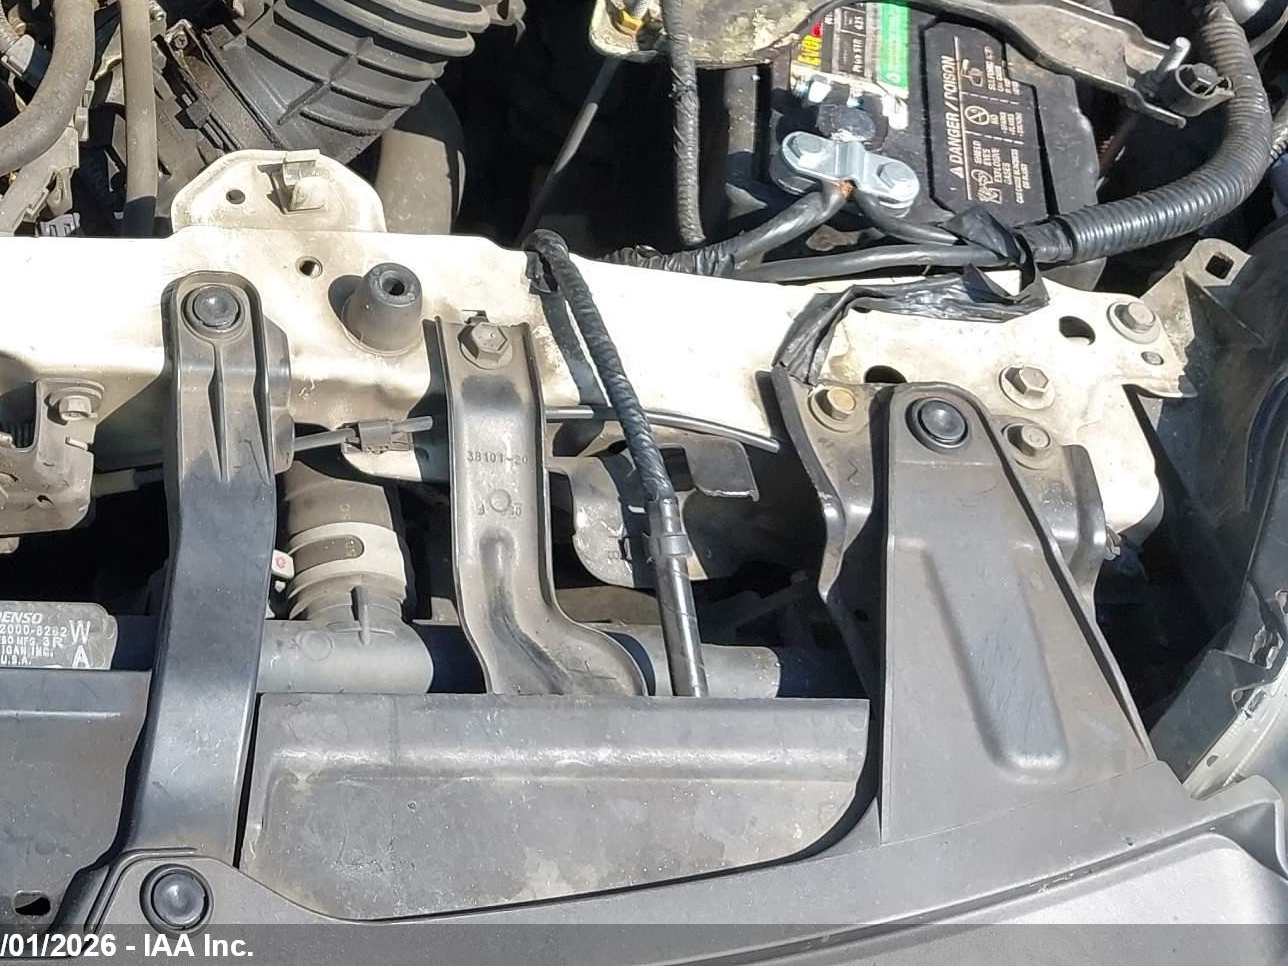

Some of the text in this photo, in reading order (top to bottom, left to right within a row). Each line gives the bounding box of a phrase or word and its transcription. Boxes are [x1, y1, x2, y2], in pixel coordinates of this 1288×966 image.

[941, 55, 958, 101] POISON
[945, 112, 964, 164] DANGER
[972, 140, 982, 164] SHIELD
[983, 148, 992, 166] EYES
[992, 148, 1003, 183] EXPLOSIVE
[1002, 162, 1012, 185] GASES
[69, 619, 91, 645] W
[0, 655, 32, 666] U.S.A.
[72, 644, 91, 668] A
